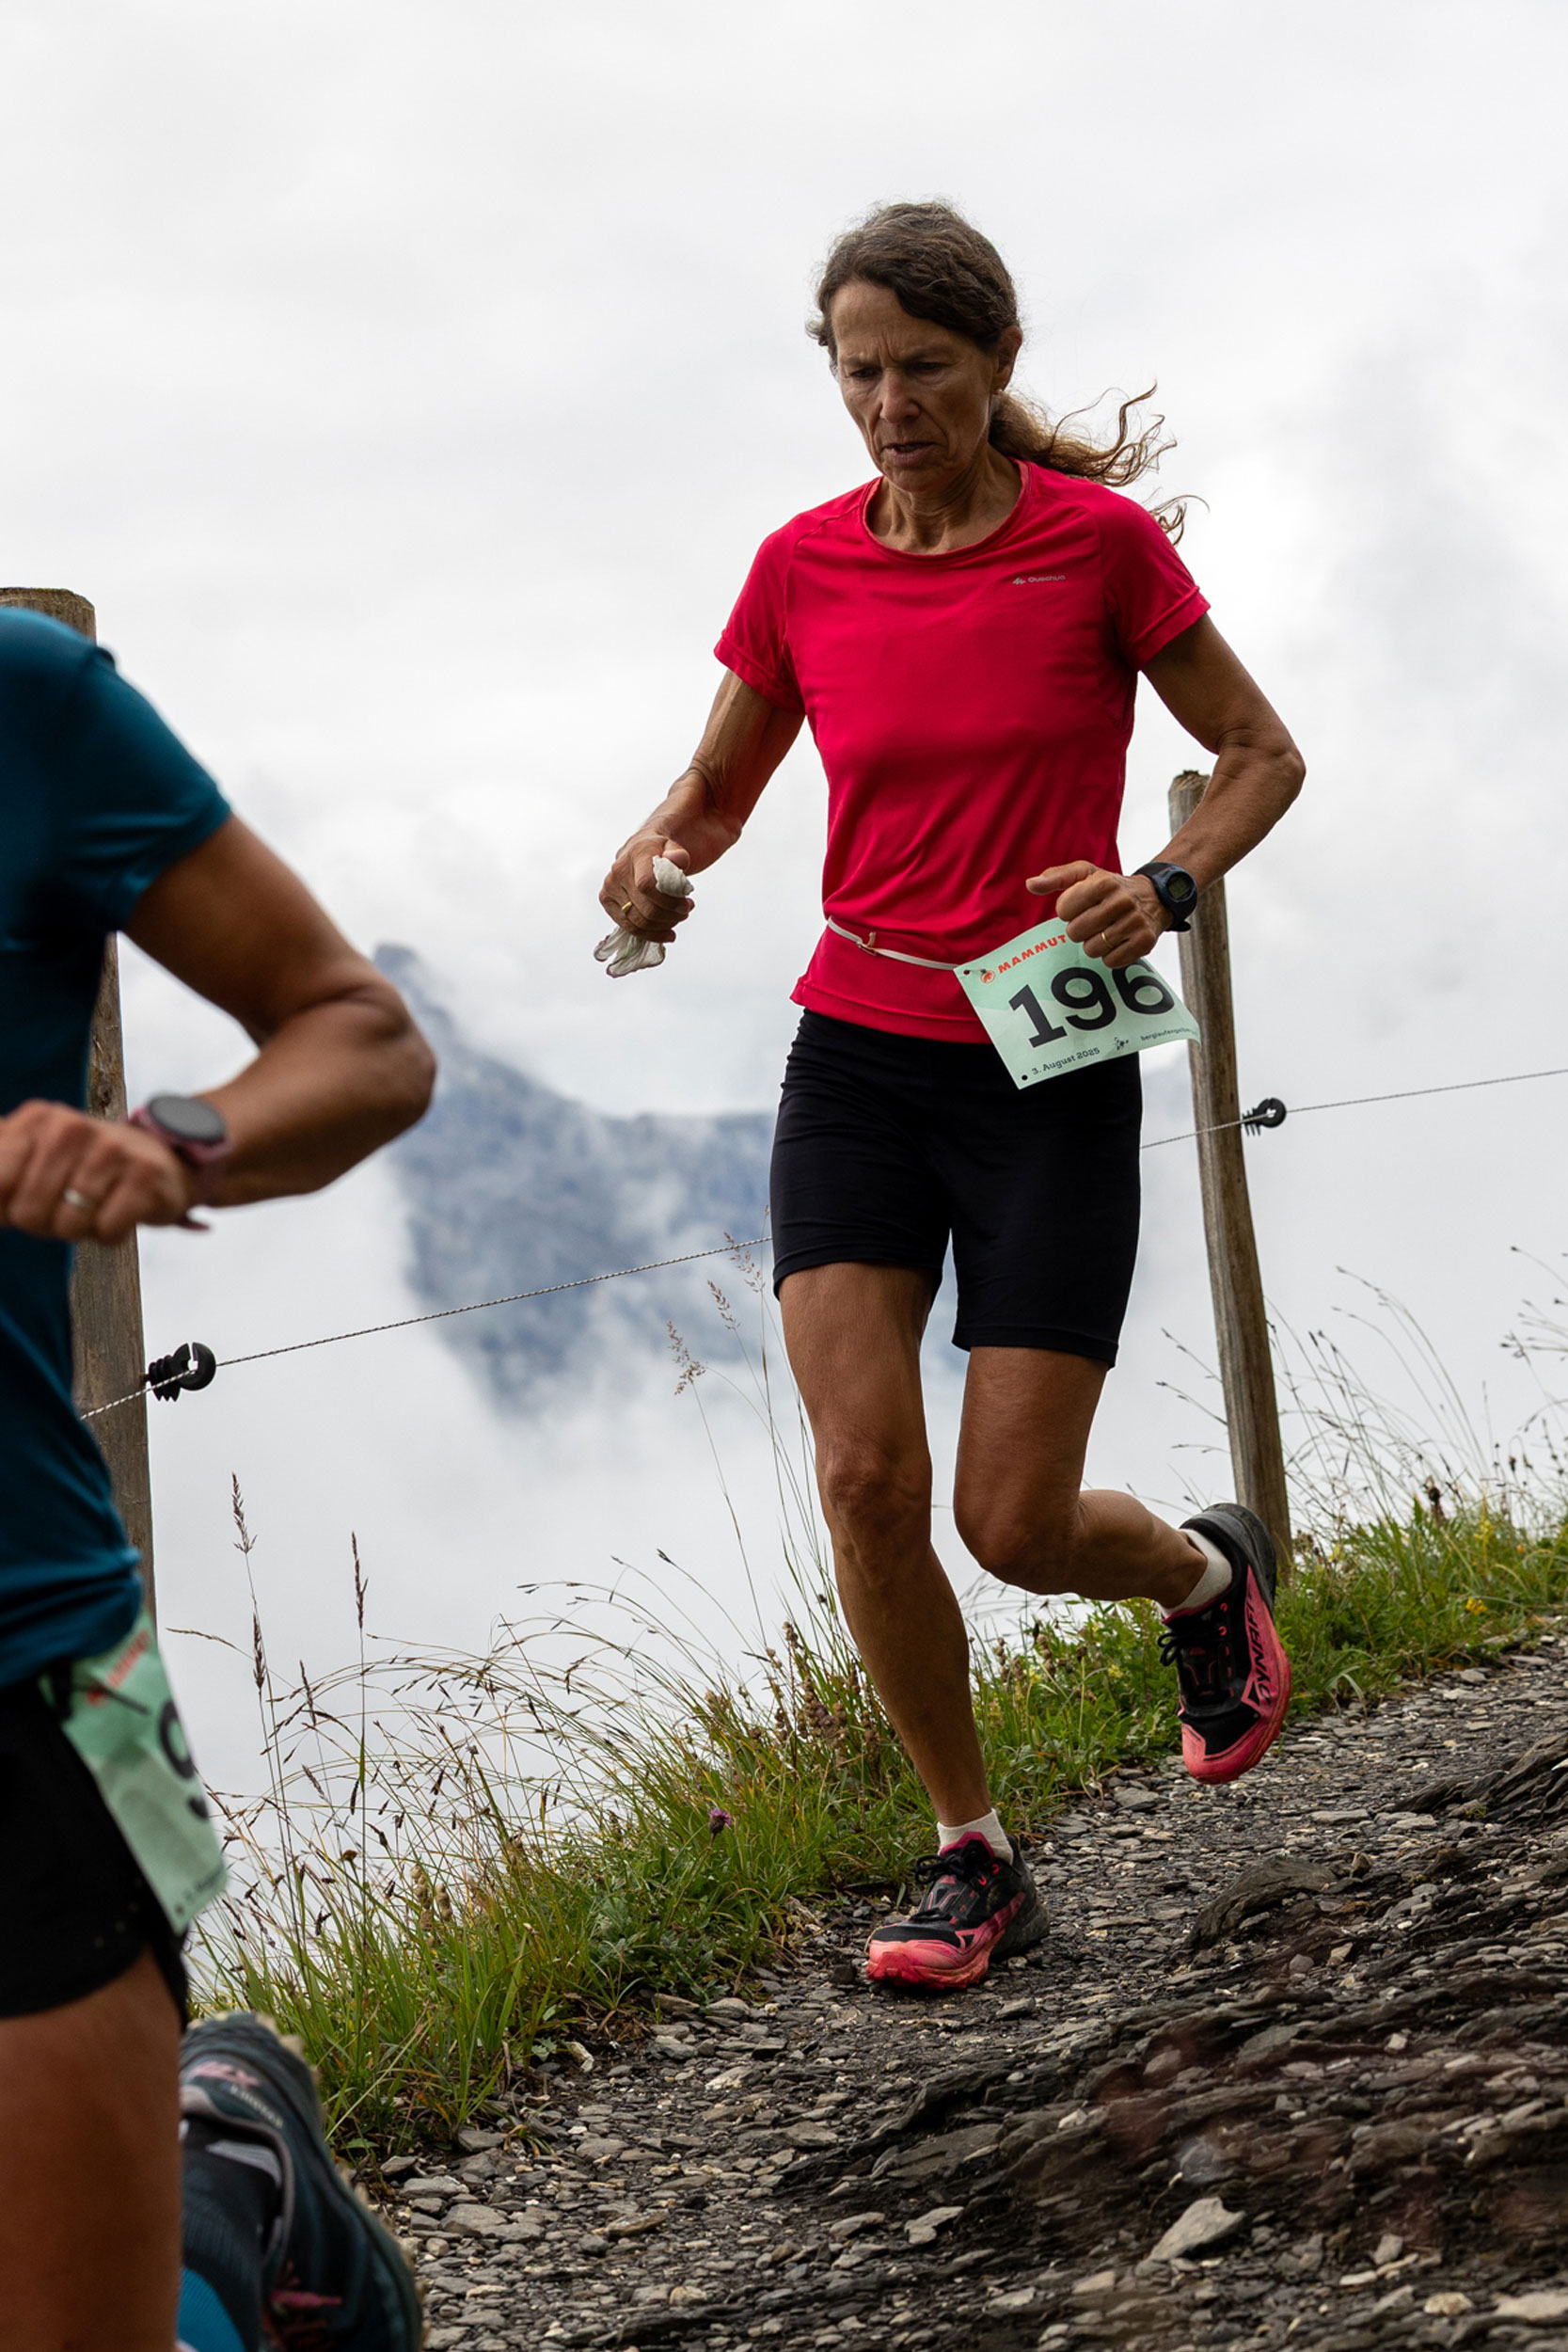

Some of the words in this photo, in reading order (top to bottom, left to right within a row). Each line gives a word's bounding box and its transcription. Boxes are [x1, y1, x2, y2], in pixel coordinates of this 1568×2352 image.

[998, 934, 1068, 974] MAMMUT
[1008, 956, 1175, 1049] 196
[1032, 1067, 1042, 1075] 3.
[1043, 1055, 1076, 1070] August
[1076, 1046, 1101, 1060] 2025
